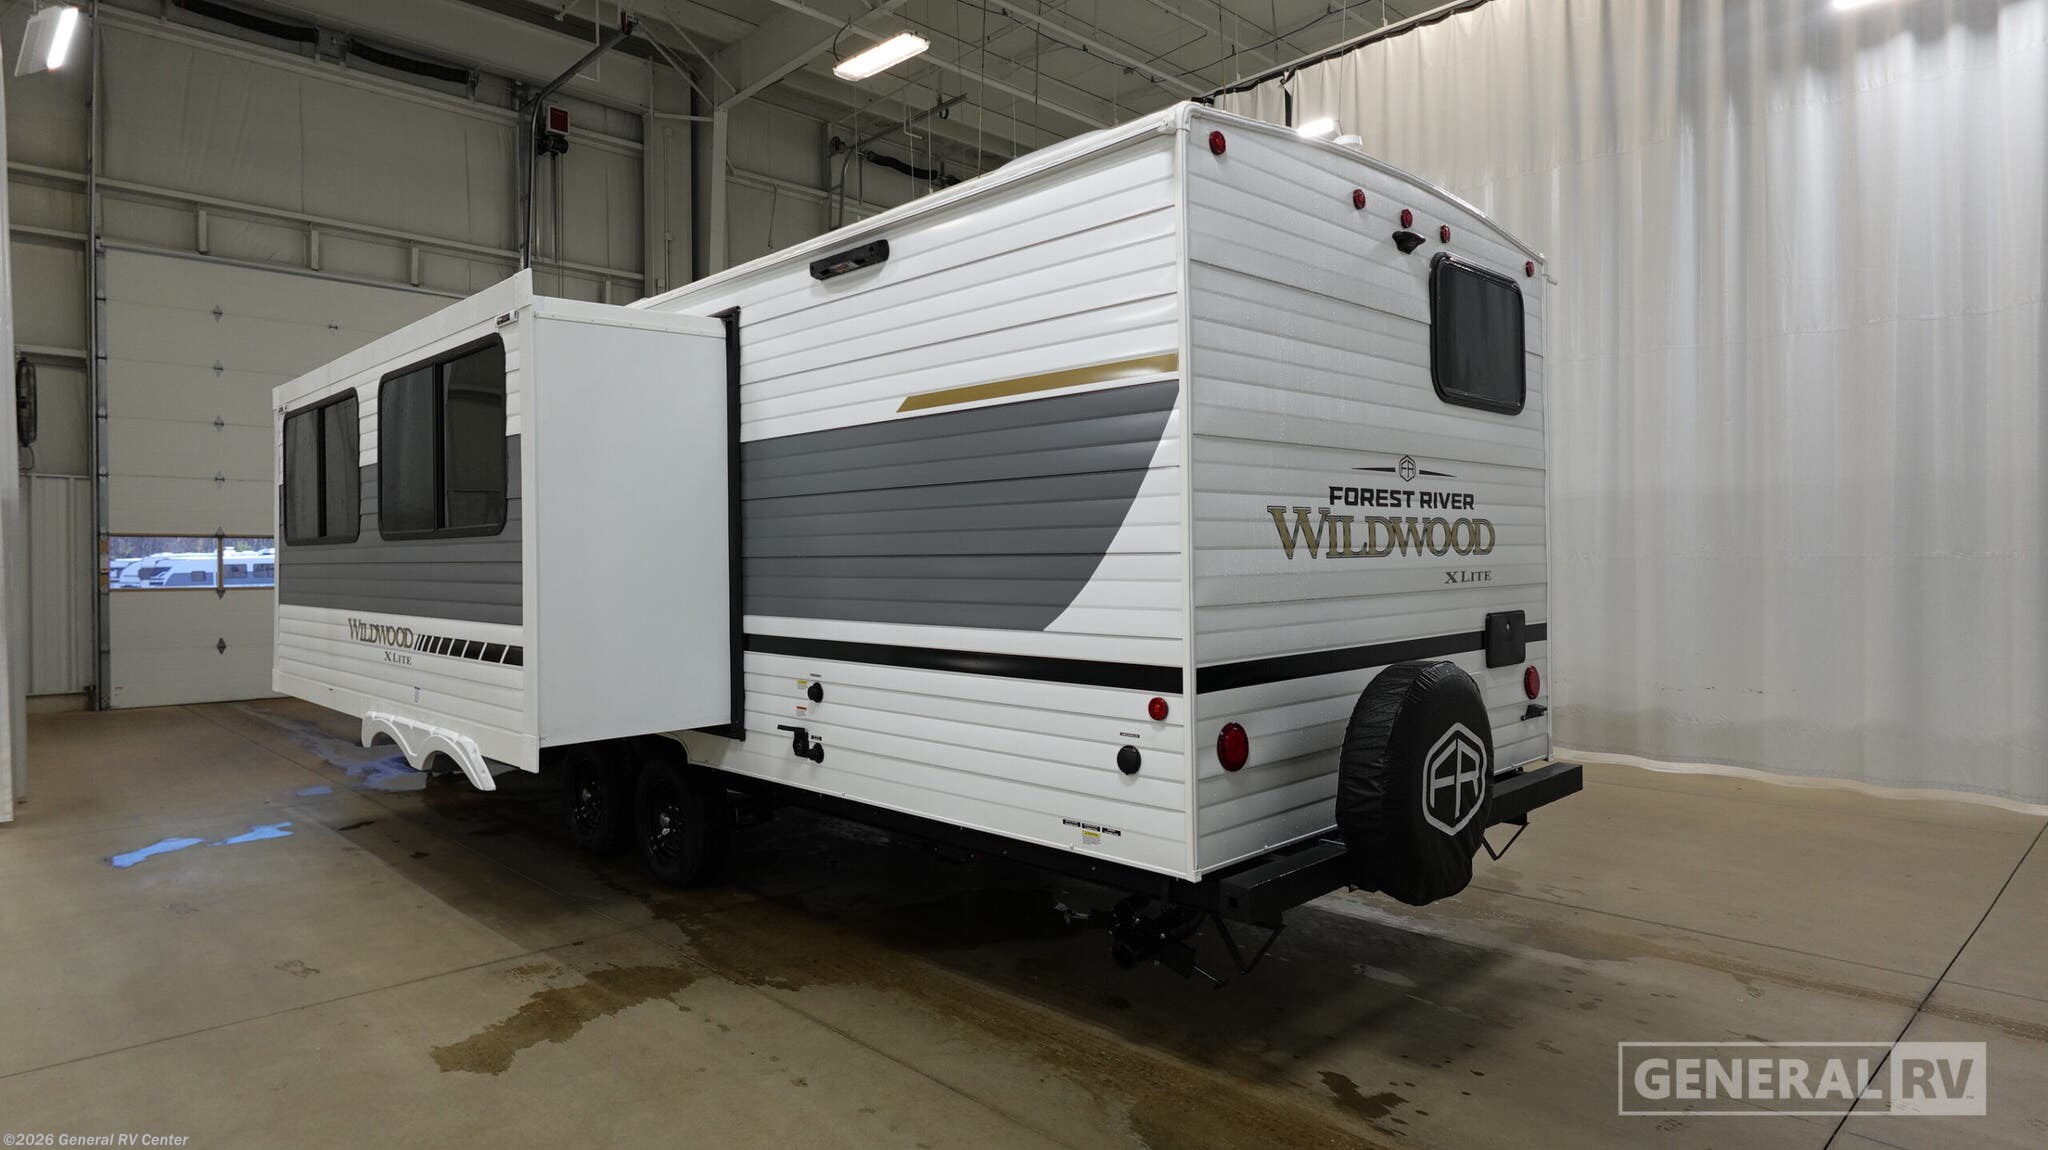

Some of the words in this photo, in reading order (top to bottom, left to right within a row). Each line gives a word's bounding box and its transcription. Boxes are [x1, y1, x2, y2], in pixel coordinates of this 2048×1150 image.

[1328, 486, 1415, 508] FOREST
[1419, 491, 1475, 510] RIVER
[1267, 505, 1496, 560] WILDWOOD
[1444, 571, 1458, 584] X
[348, 618, 414, 649] WILDWOOD
